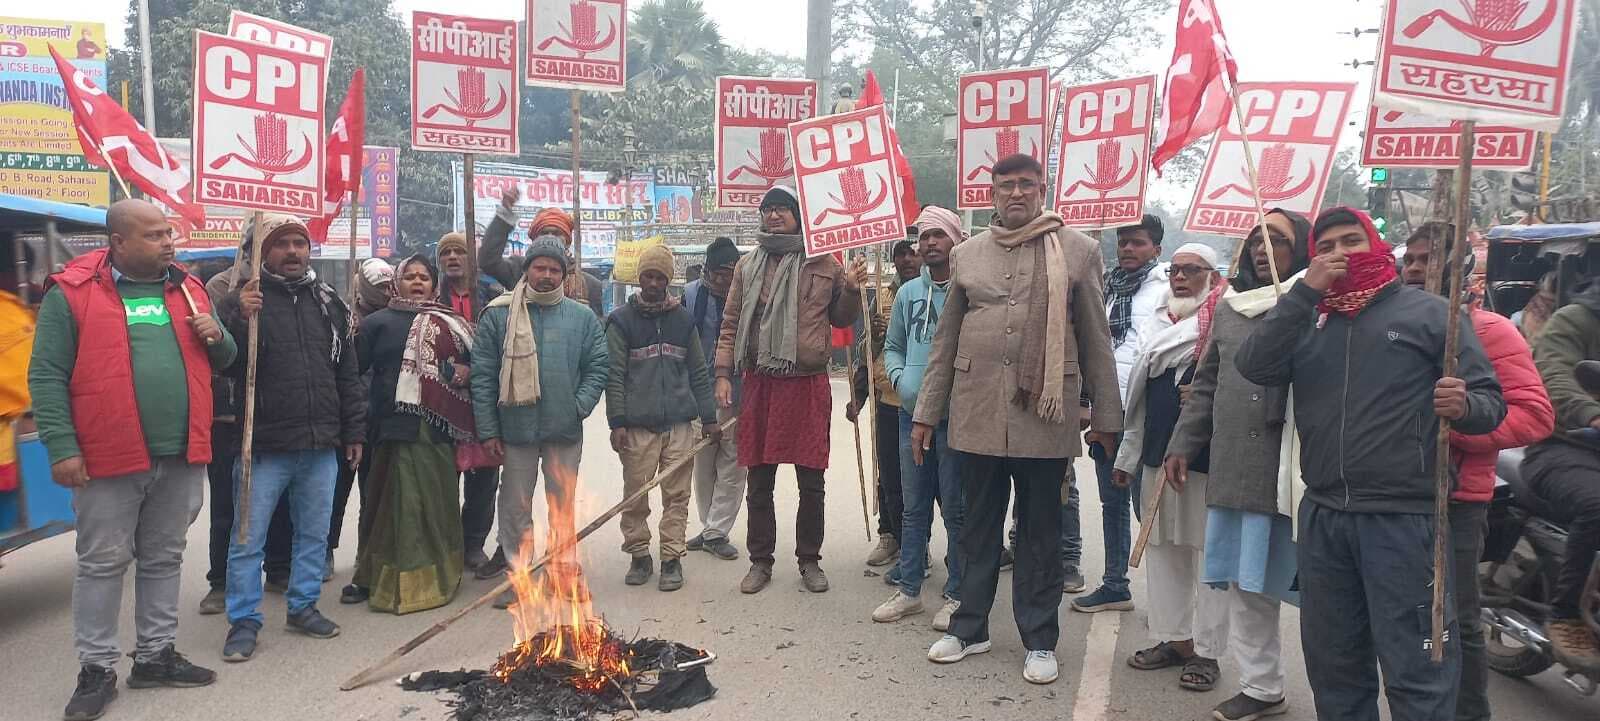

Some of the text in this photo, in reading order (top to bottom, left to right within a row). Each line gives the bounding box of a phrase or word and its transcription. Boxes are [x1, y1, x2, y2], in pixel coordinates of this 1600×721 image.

[417, 18, 513, 64] सीपीआई
[32, 64, 60, 73] Boar
[205, 45, 318, 112] CPI
[535, 61, 618, 80] SAHARSA
[1400, 62, 1549, 103] सहरसा
[724, 84, 813, 120] सीपीआई
[963, 77, 1043, 123] CPI
[1068, 84, 1149, 136] CPI
[1227, 89, 1348, 138] CPI
[34, 129, 70, 138] Session
[39, 141, 72, 150] Limited
[422, 131, 506, 147] सहरसा
[796, 115, 885, 169] CPI
[1376, 135, 1519, 158] SAHASA
[58, 174, 97, 185] Saharsa
[206, 181, 315, 210] SAHARSA
[1061, 202, 1136, 220] SAHARSA
[1198, 208, 1257, 229] SAHA
[813, 220, 898, 247] SAHARSA
